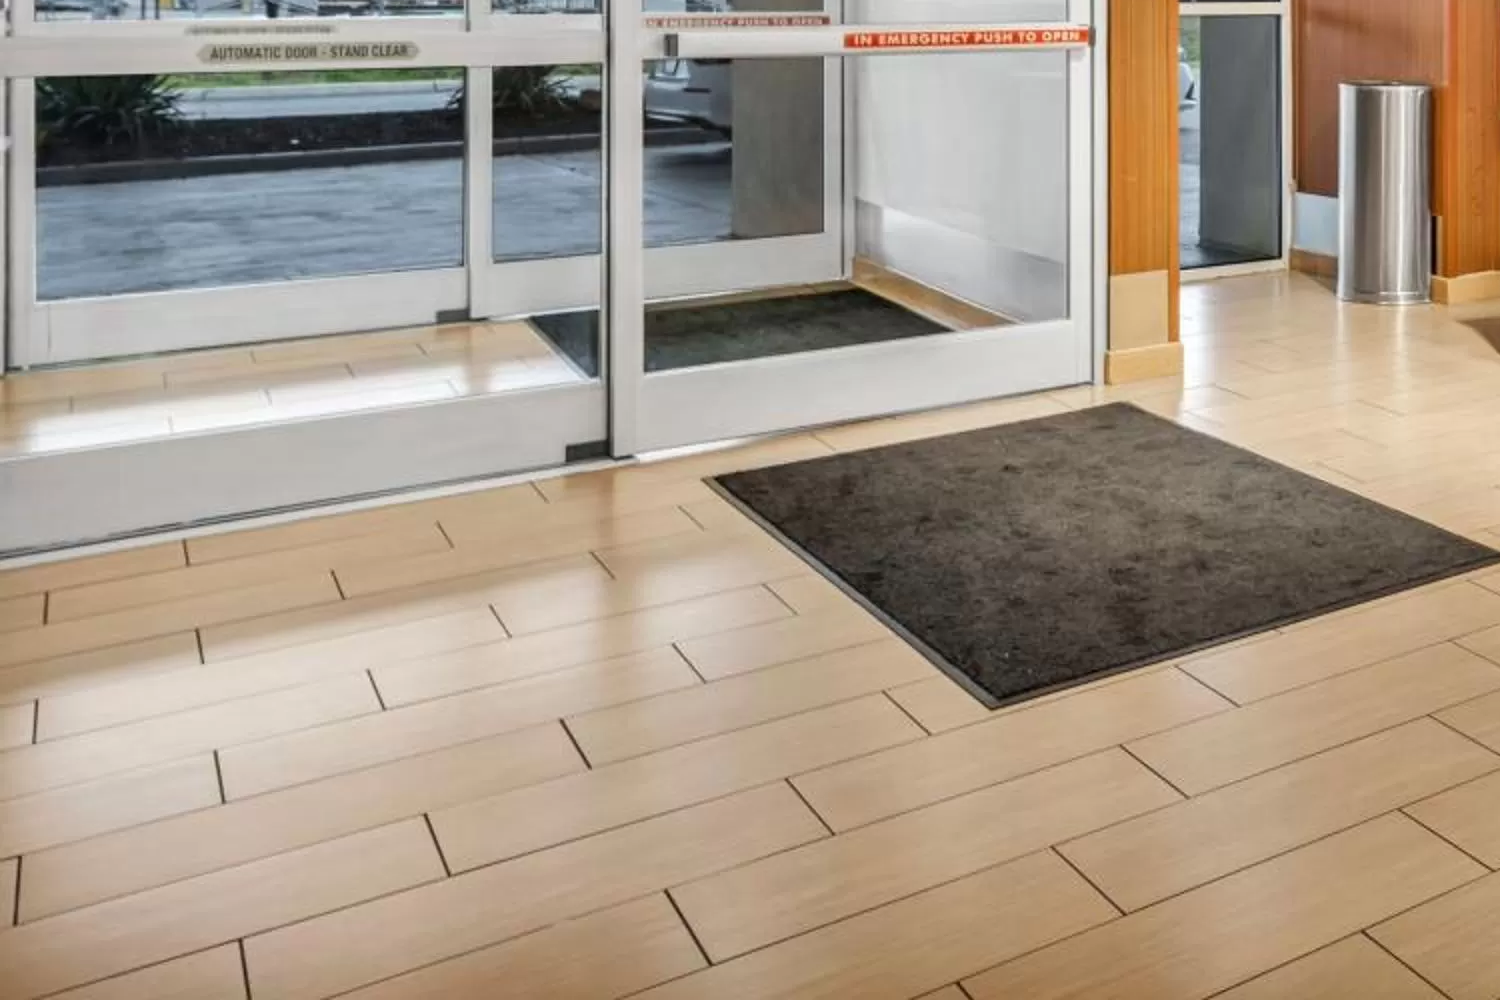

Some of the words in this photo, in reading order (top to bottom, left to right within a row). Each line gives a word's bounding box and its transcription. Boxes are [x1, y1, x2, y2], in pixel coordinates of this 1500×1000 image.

[854, 34, 872, 46] IN
[879, 33, 969, 46] EMERGENCY
[975, 32, 1013, 43] PUSH
[1018, 32, 1037, 42] TO
[1042, 31, 1080, 42] OPEN
[210, 45, 281, 60] AUTOMATIC
[285, 44, 317, 58] DOOR
[329, 44, 369, 58] STAND
[371, 42, 409, 57] CLEAR
